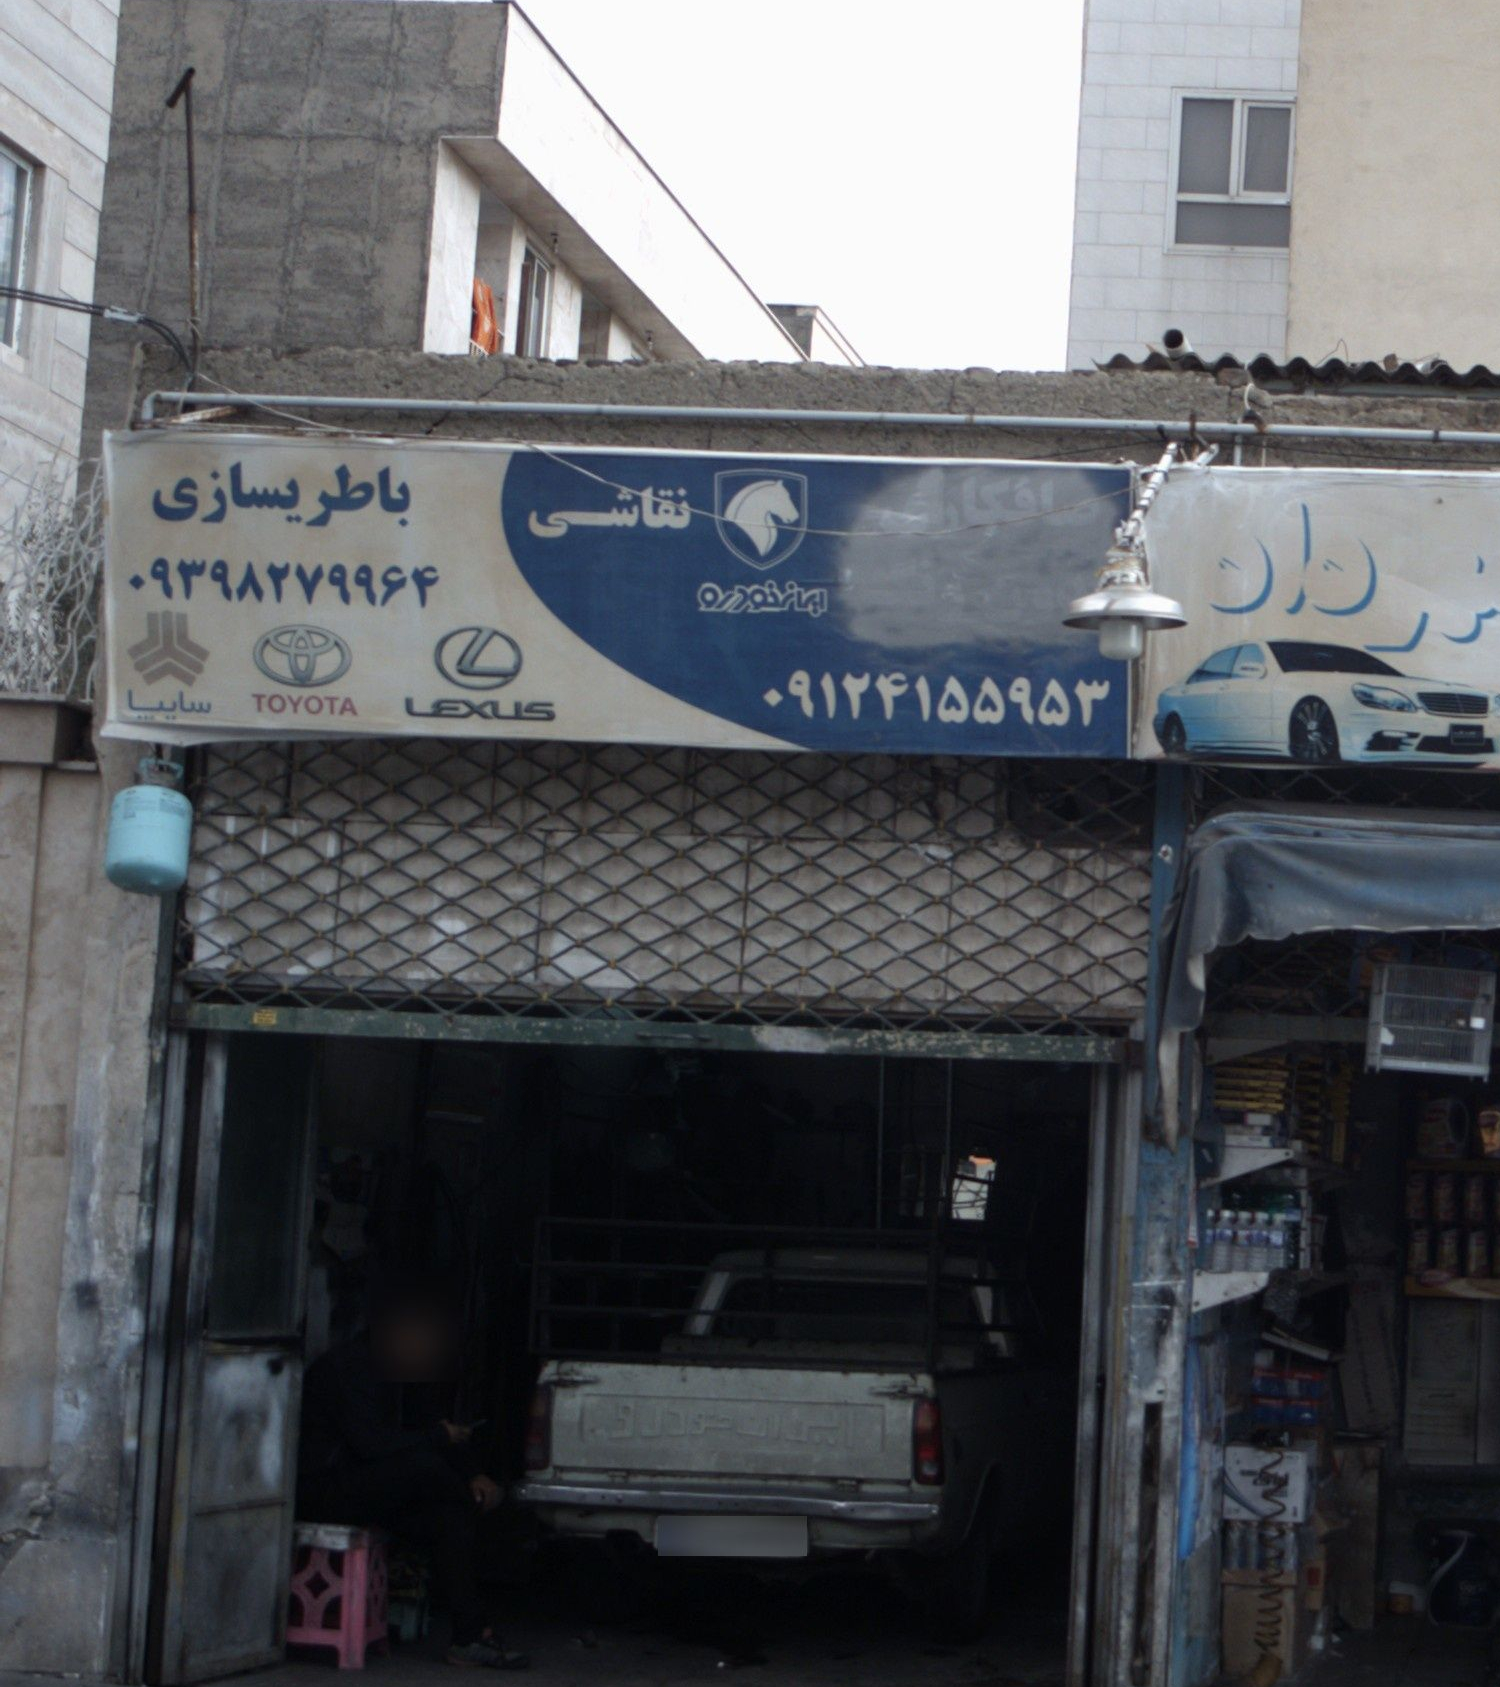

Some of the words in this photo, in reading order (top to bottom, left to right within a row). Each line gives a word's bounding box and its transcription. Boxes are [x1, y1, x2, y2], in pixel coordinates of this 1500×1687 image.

[528, 486, 692, 540] نقاشی
[127, 556, 441, 609] ۰۹۳۹۸۲۷۹۹۶۴
[126, 688, 213, 722] سایپا
[252, 693, 359, 717] TOYOTA
[404, 697, 556, 722] LEXUS
[762, 669, 1112, 728] ۰۹۱۲۴۱۵۵۹۵۳
